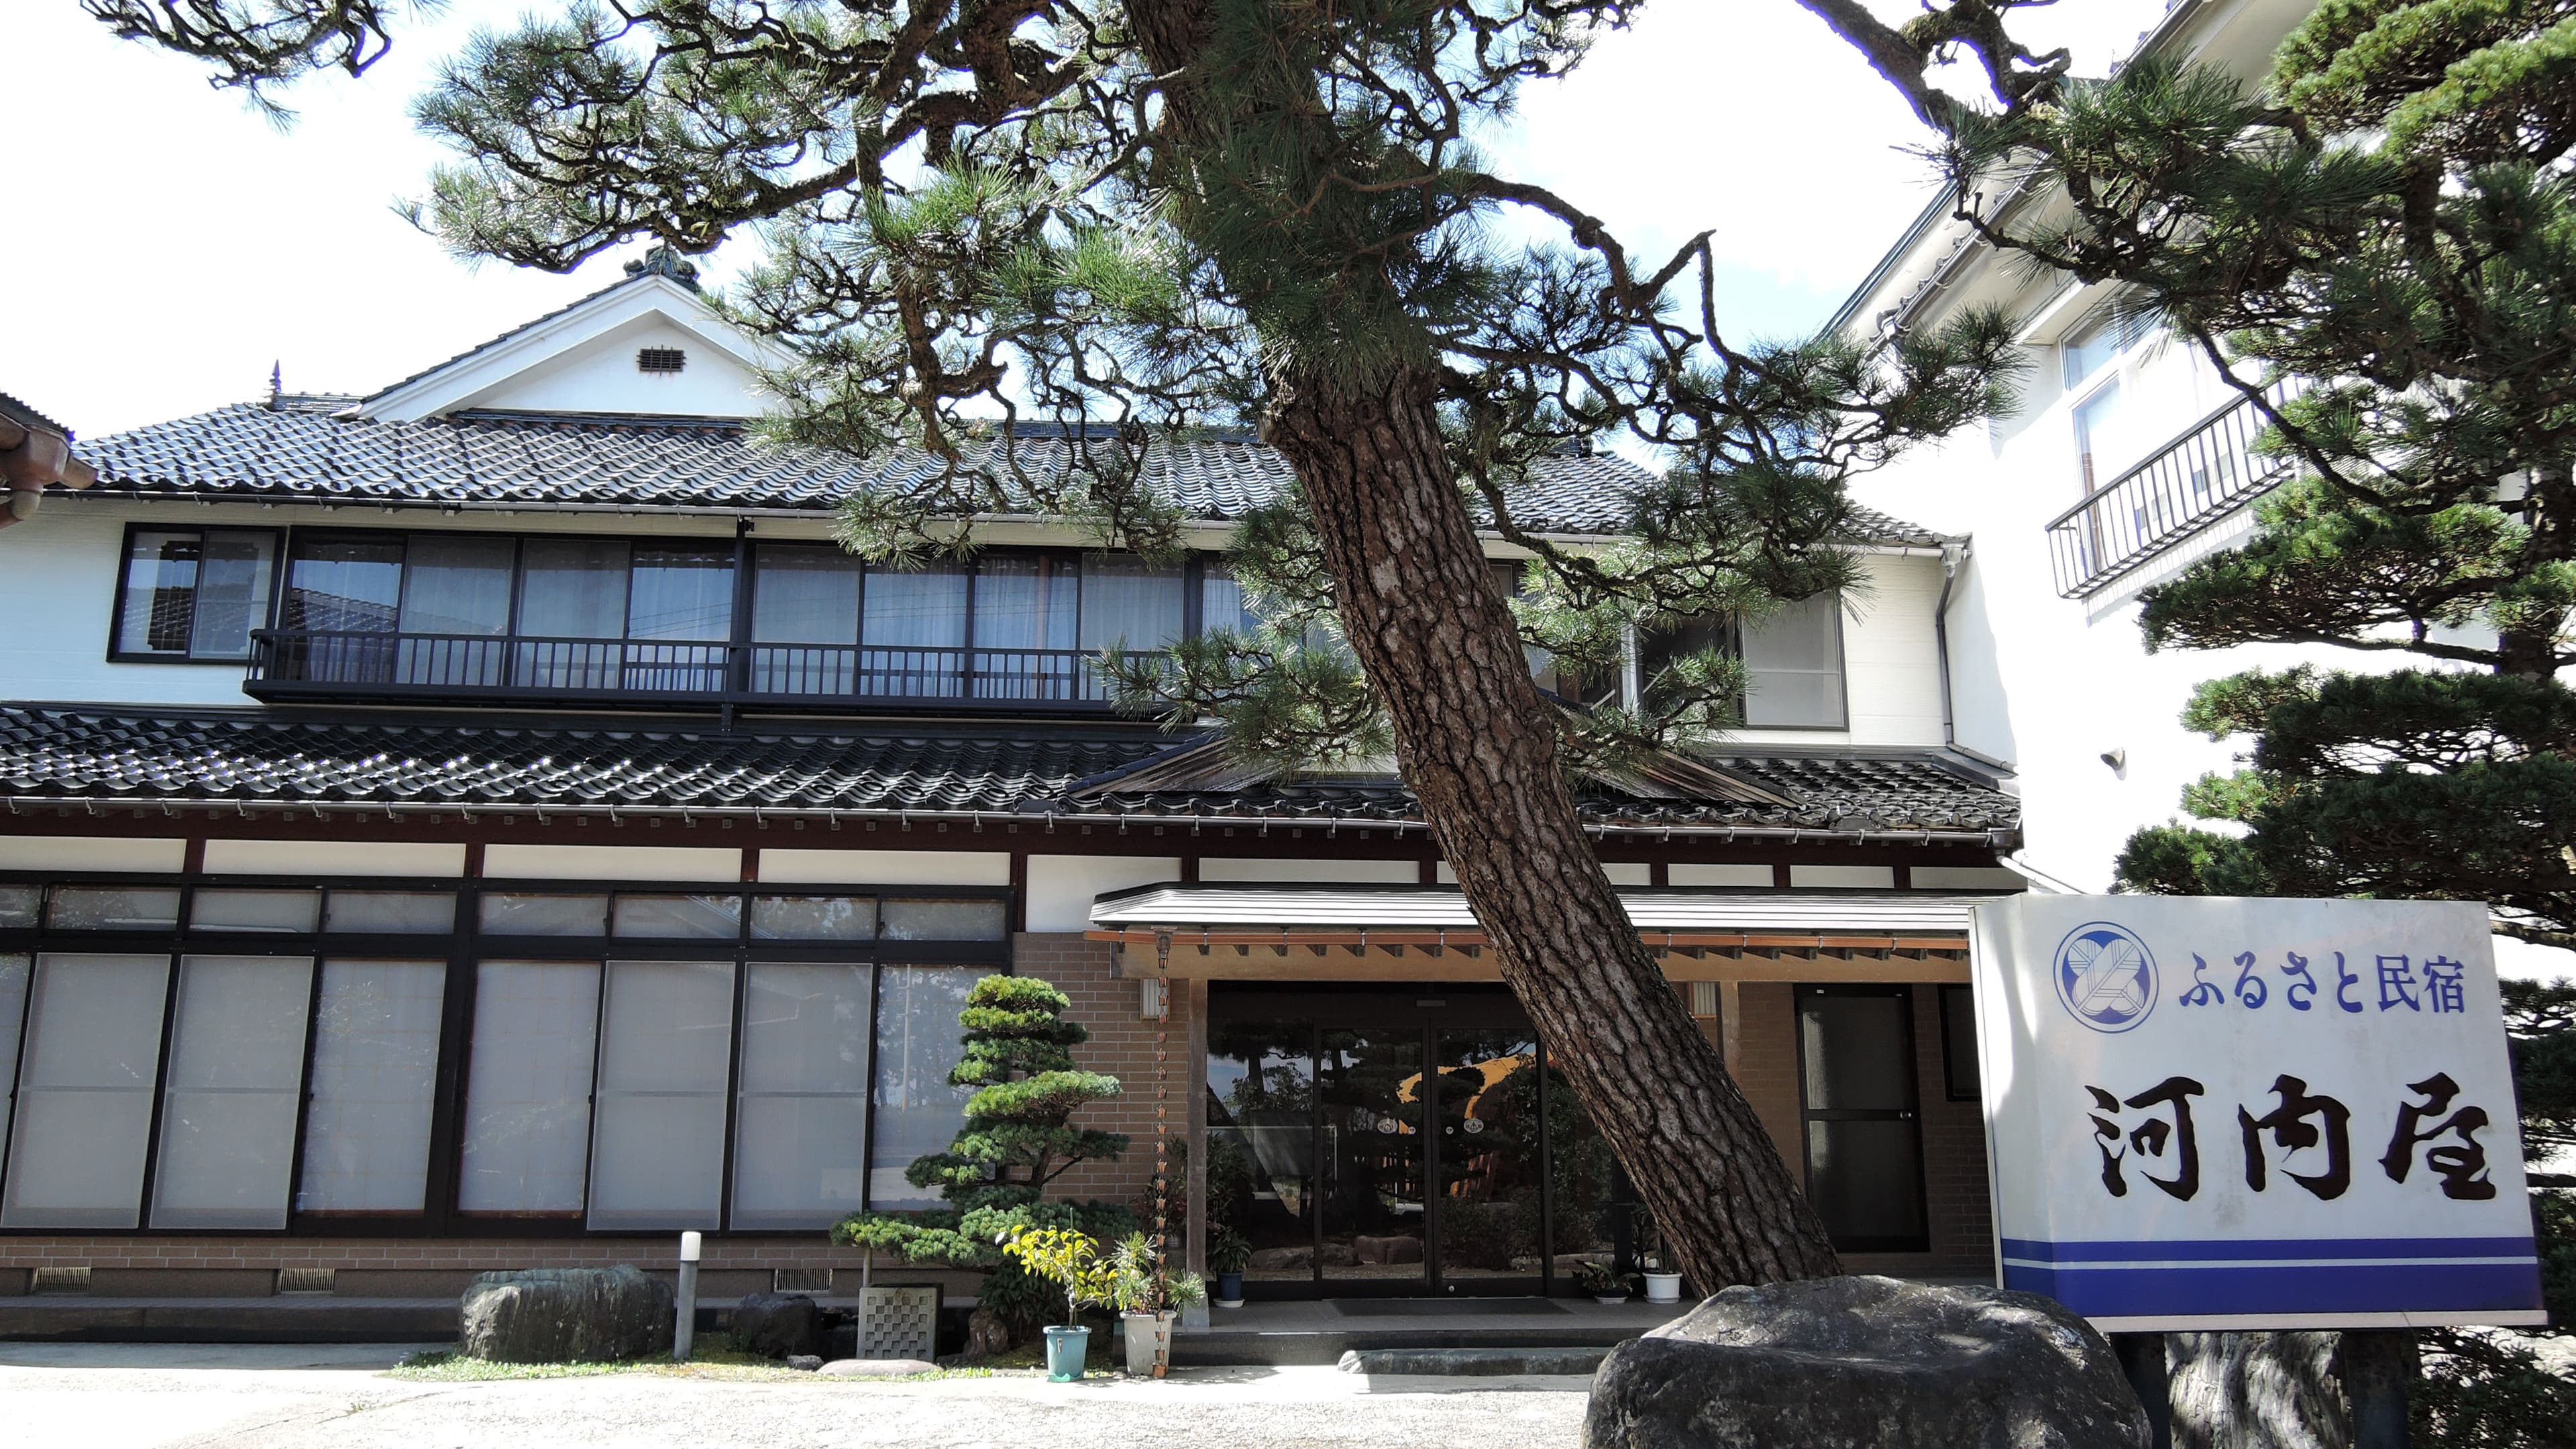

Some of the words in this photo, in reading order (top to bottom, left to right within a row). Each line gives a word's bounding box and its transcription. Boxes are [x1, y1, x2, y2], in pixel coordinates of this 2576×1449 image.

[2179, 951, 2465, 1014] ふるさと民宿
[2084, 1072, 2497, 1202] 河内屋
